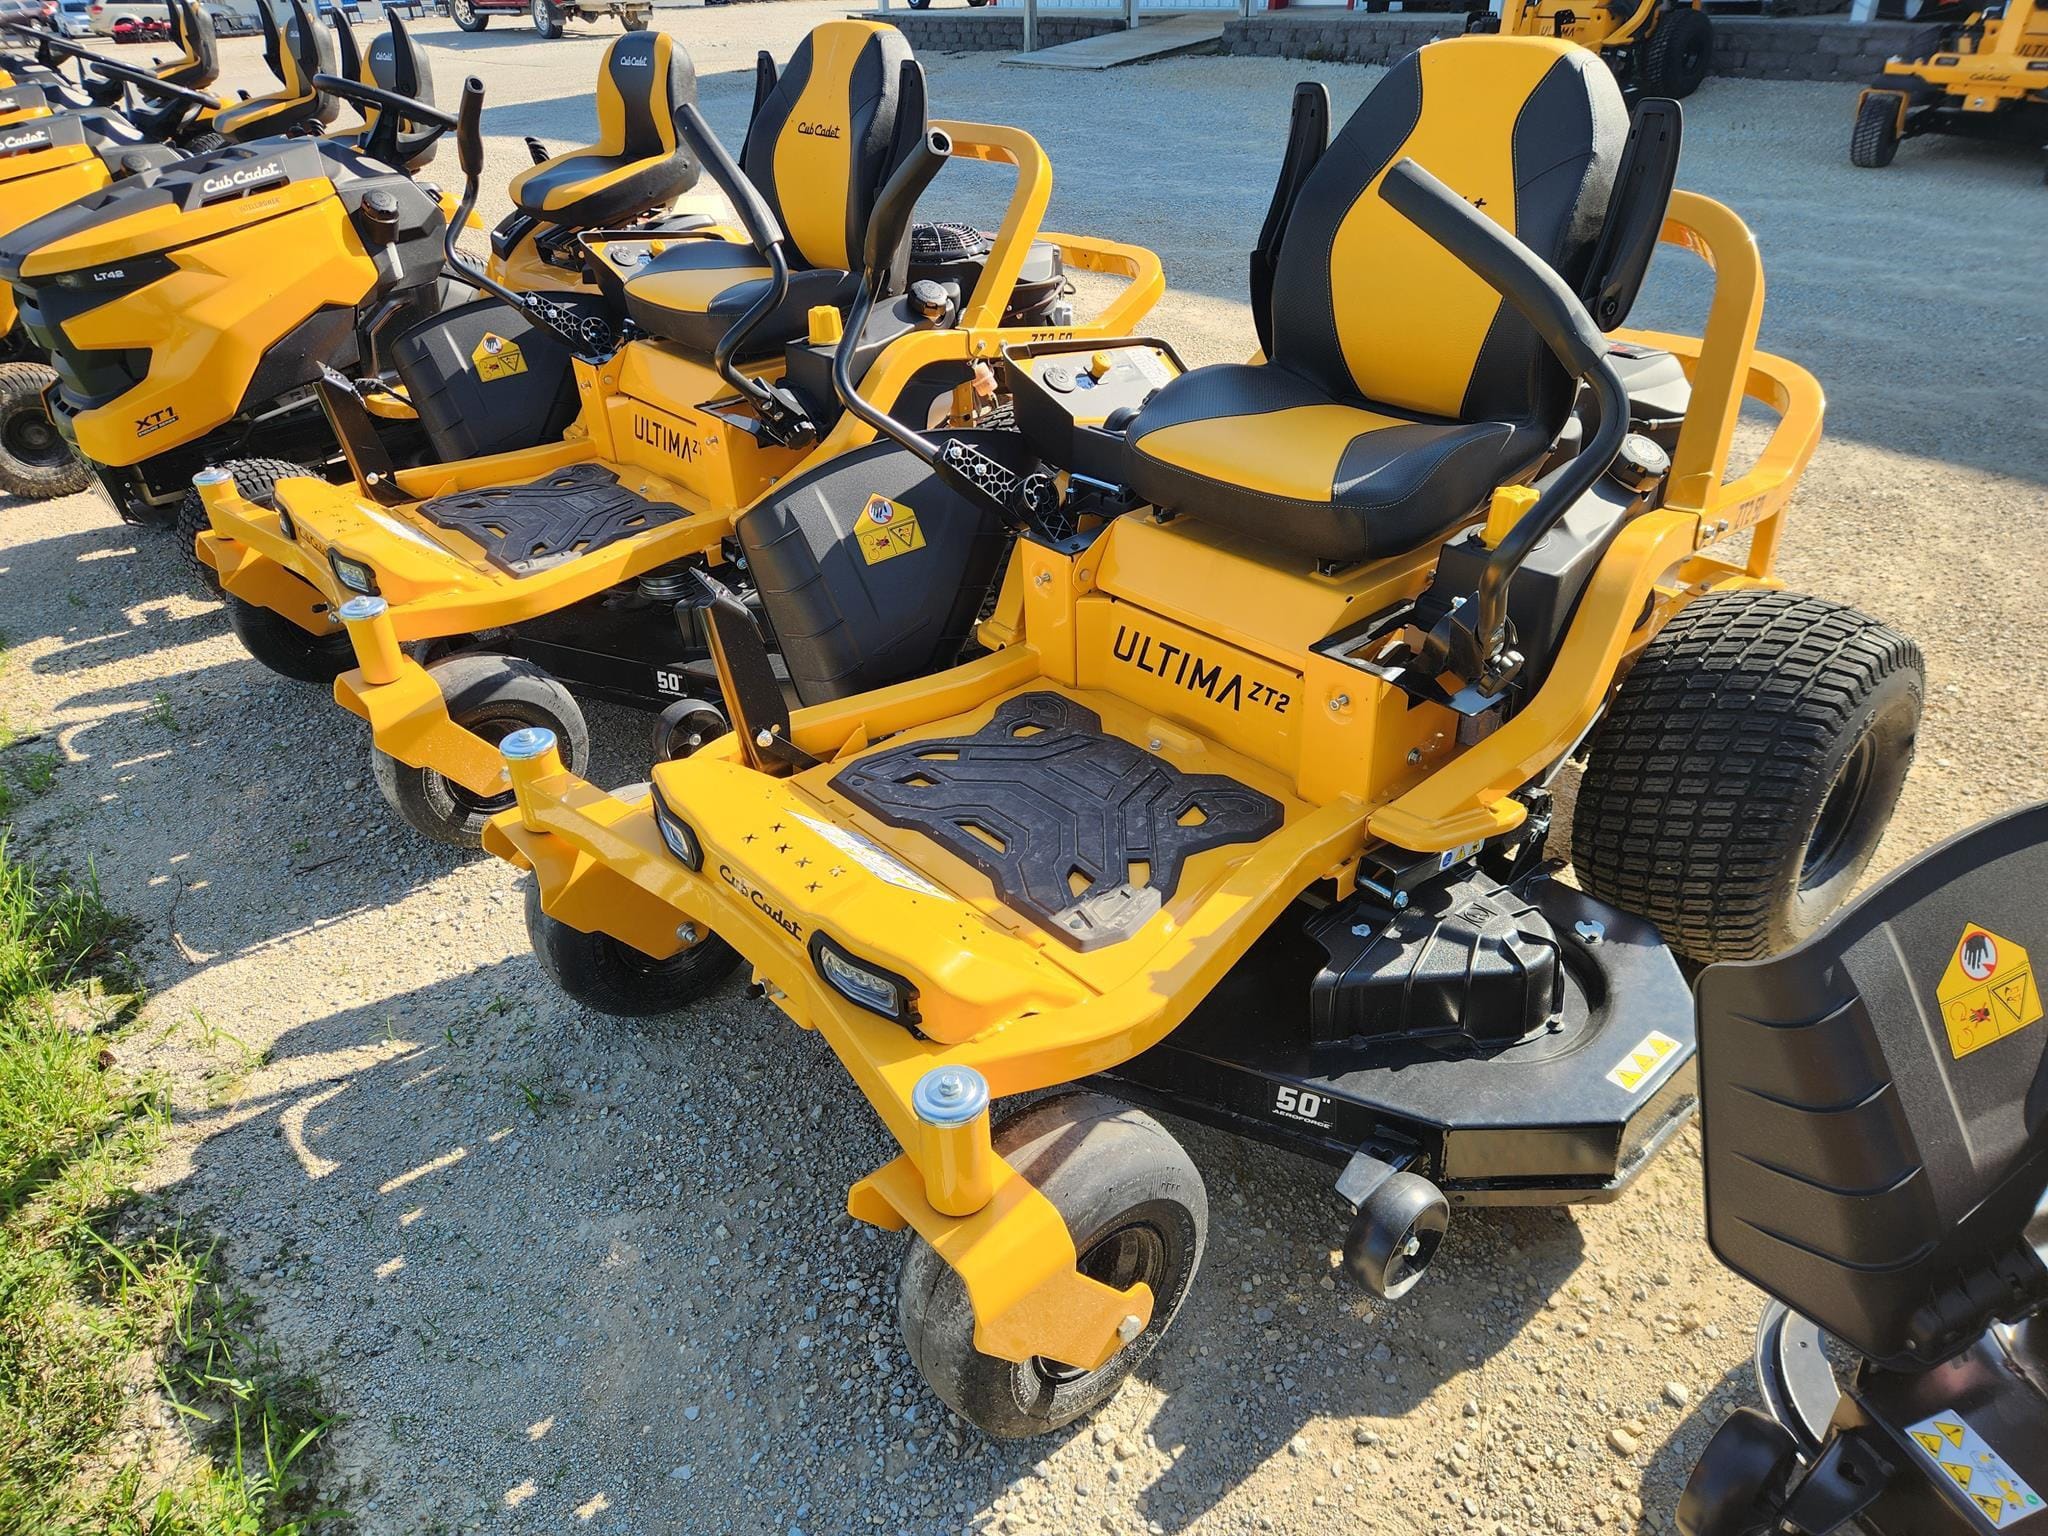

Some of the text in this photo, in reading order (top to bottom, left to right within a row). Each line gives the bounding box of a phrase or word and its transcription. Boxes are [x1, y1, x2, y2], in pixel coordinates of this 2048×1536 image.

[5, 130, 47, 148] Cadet
[797, 121, 841, 139] Cub Cadet
[203, 162, 278, 193] Cub Cadet
[93, 269, 125, 281] LT42
[135, 406, 174, 432] XT1
[634, 413, 692, 463] ULTIMA
[1112, 625, 1291, 713] ULTIMA ZT2
[719, 864, 803, 942] Cub Cadet
[1276, 1085, 1331, 1119] 50"
[1271, 1108, 1332, 1130] AEROFORCE
